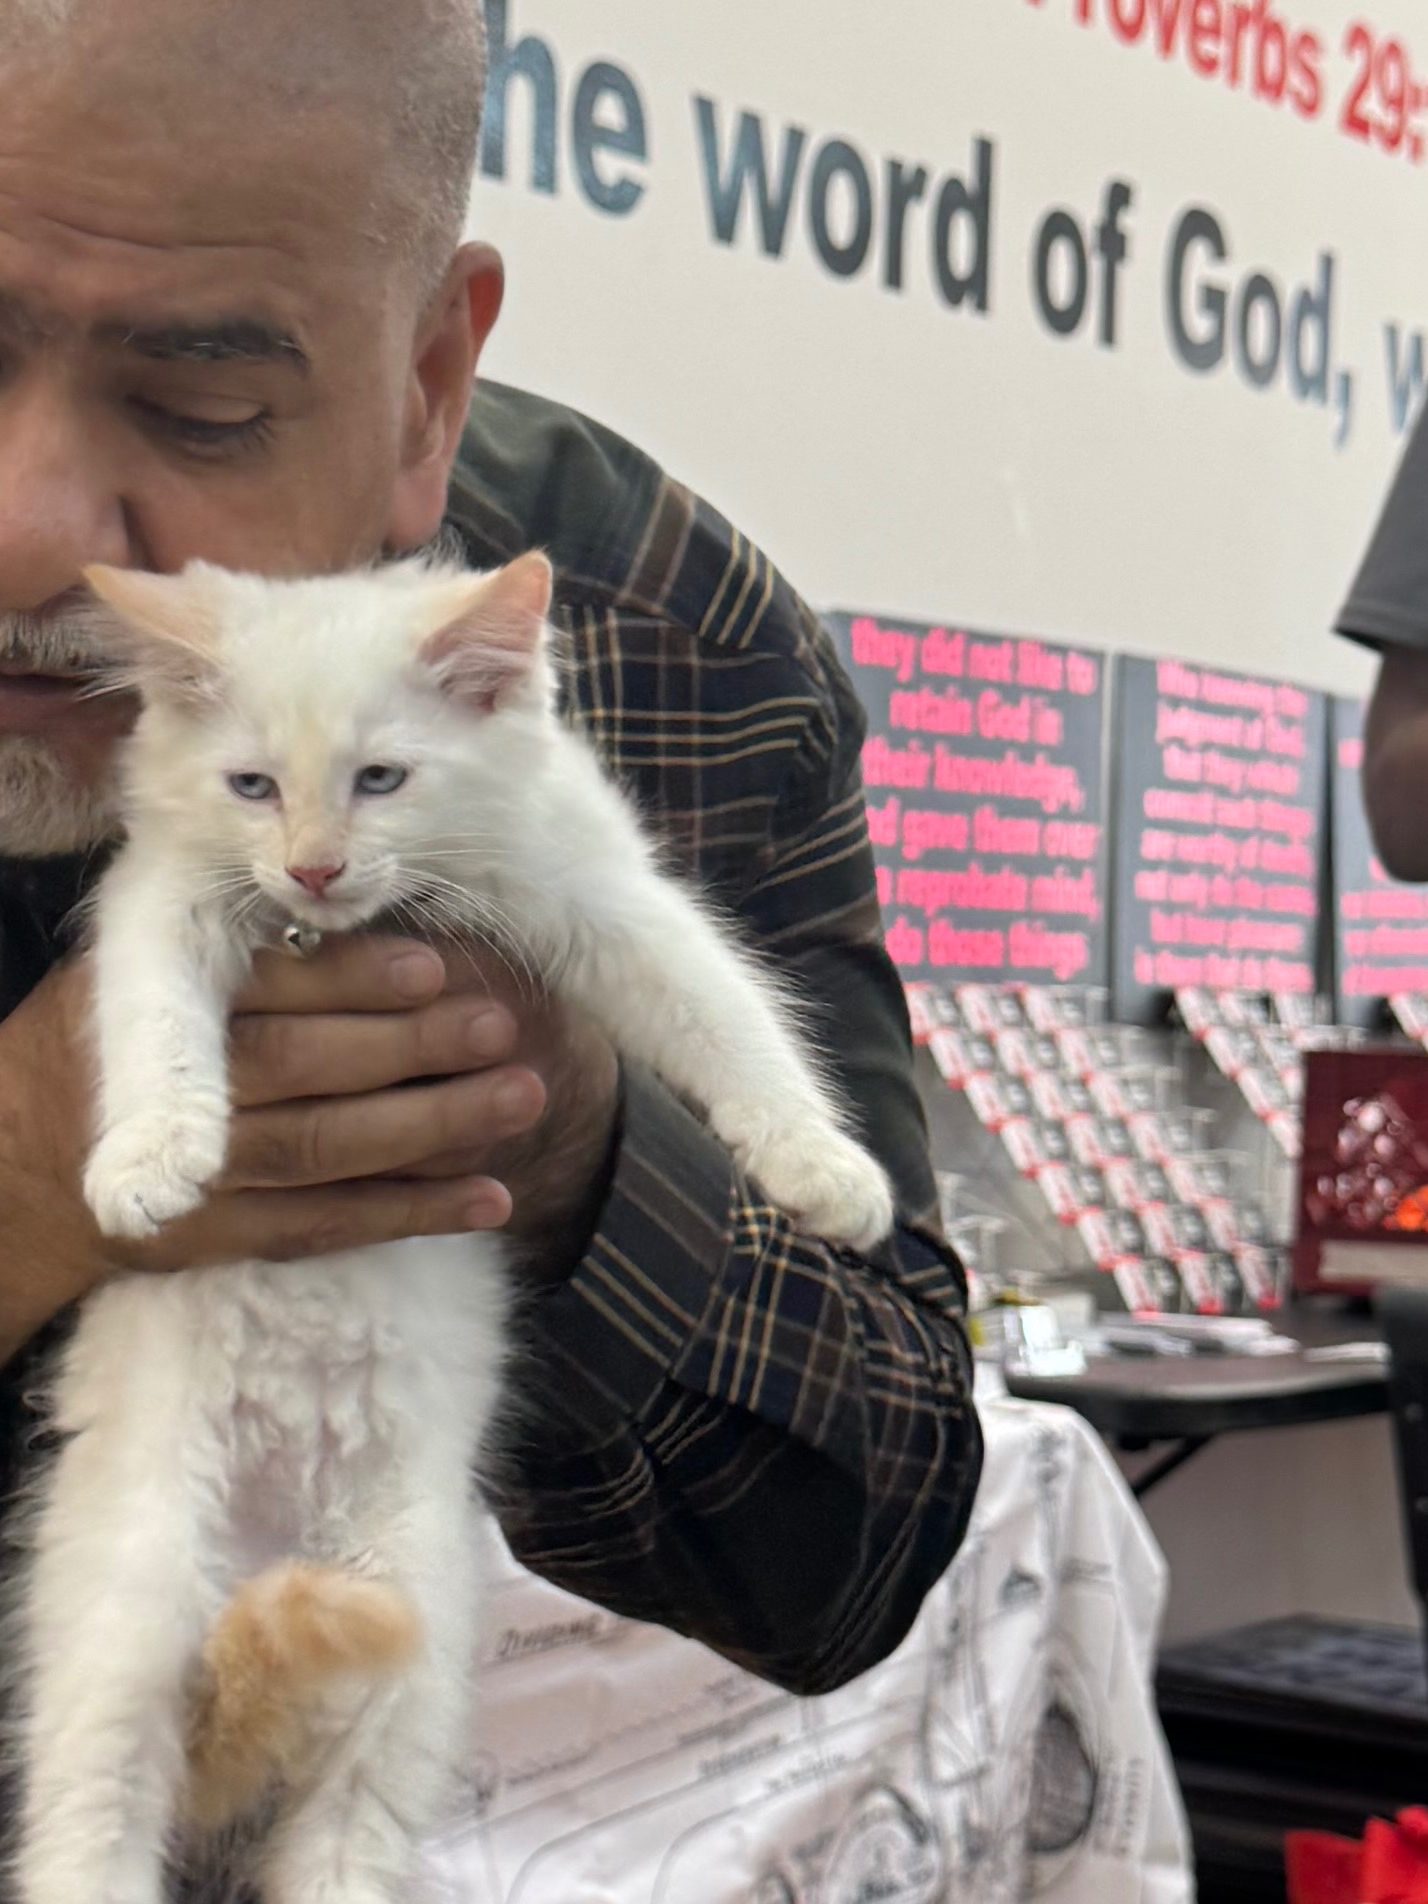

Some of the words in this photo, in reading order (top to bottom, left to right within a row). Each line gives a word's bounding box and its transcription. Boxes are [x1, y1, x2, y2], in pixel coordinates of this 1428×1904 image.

[690, 90, 995, 315] word
[1032, 179, 1132, 349] of
[1166, 206, 1352, 450] God,
